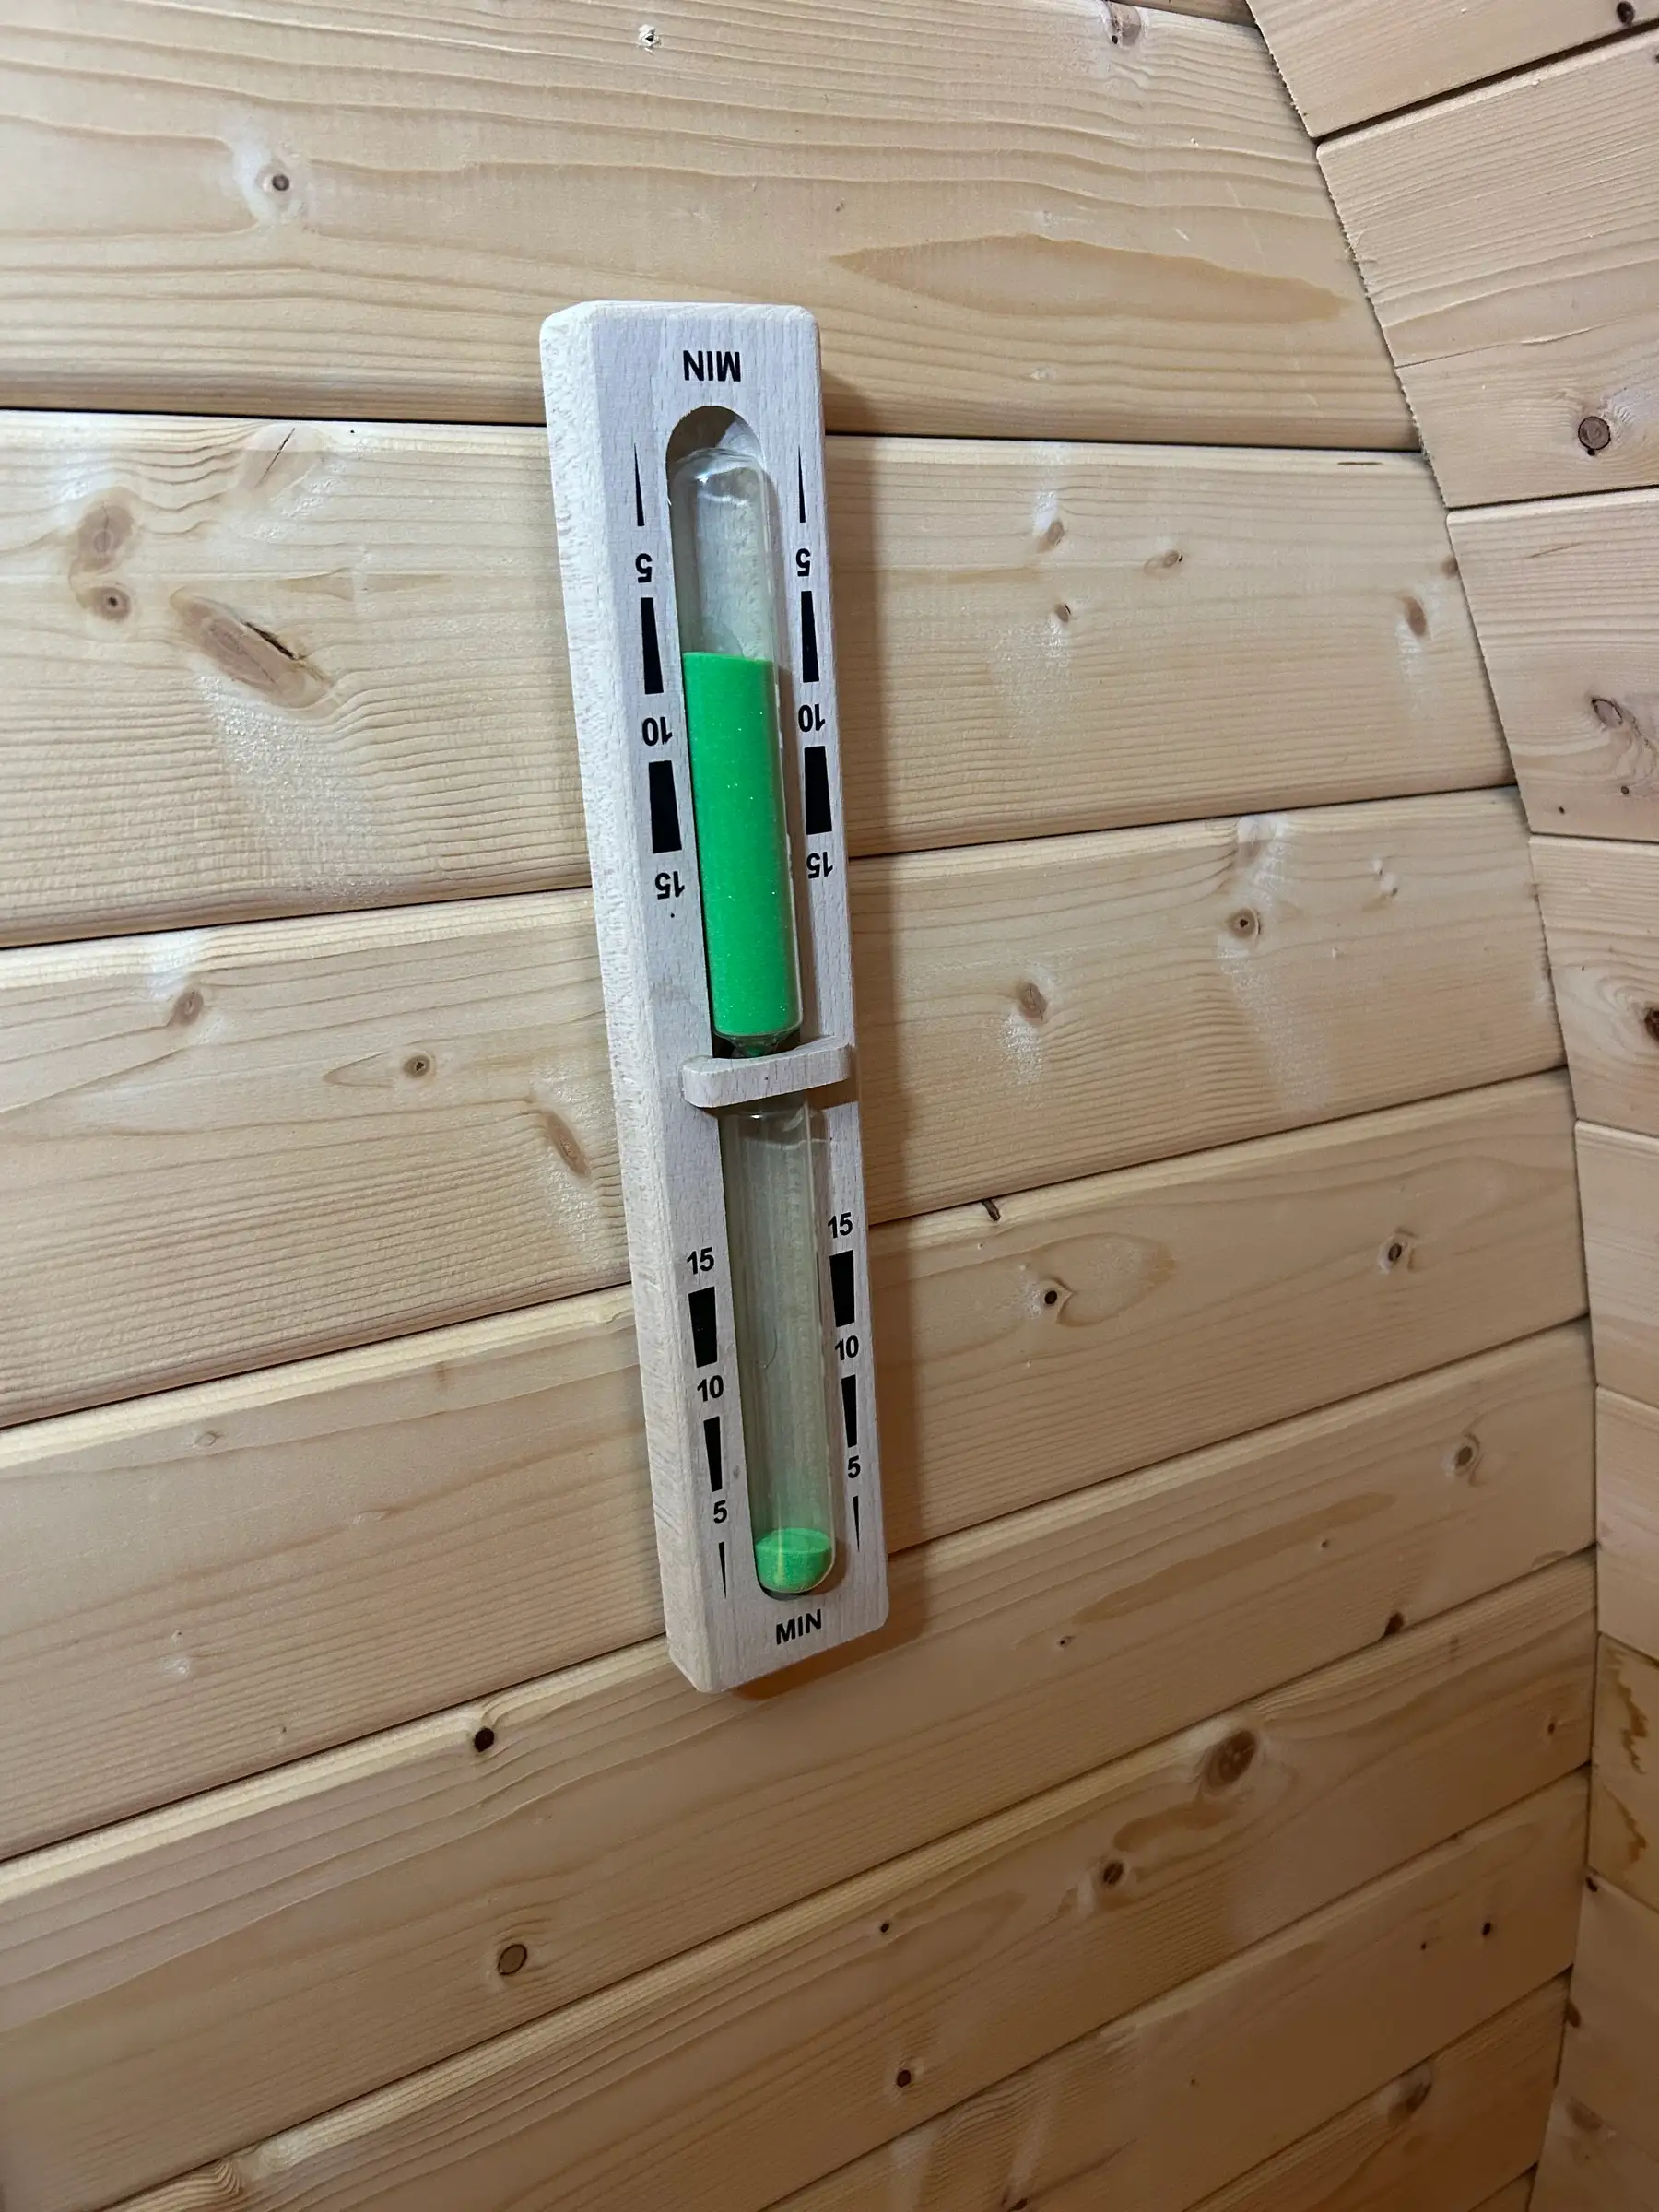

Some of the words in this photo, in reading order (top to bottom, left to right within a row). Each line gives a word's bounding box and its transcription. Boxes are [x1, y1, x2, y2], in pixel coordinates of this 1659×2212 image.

[682, 349, 742, 382] MIN
[634, 552, 653, 584] 5
[795, 547, 811, 578] 5
[641, 716, 673, 747] 10
[798, 703, 826, 733] 10
[806, 851, 834, 878] 15
[654, 870, 686, 900] 15
[828, 1211, 853, 1239] 15
[686, 1246, 715, 1276] 15
[834, 1335, 860, 1360] 10
[696, 1374, 724, 1404] 10
[847, 1454, 862, 1479] 5
[712, 1499, 728, 1524] 5
[775, 1610, 823, 1645] MIN
